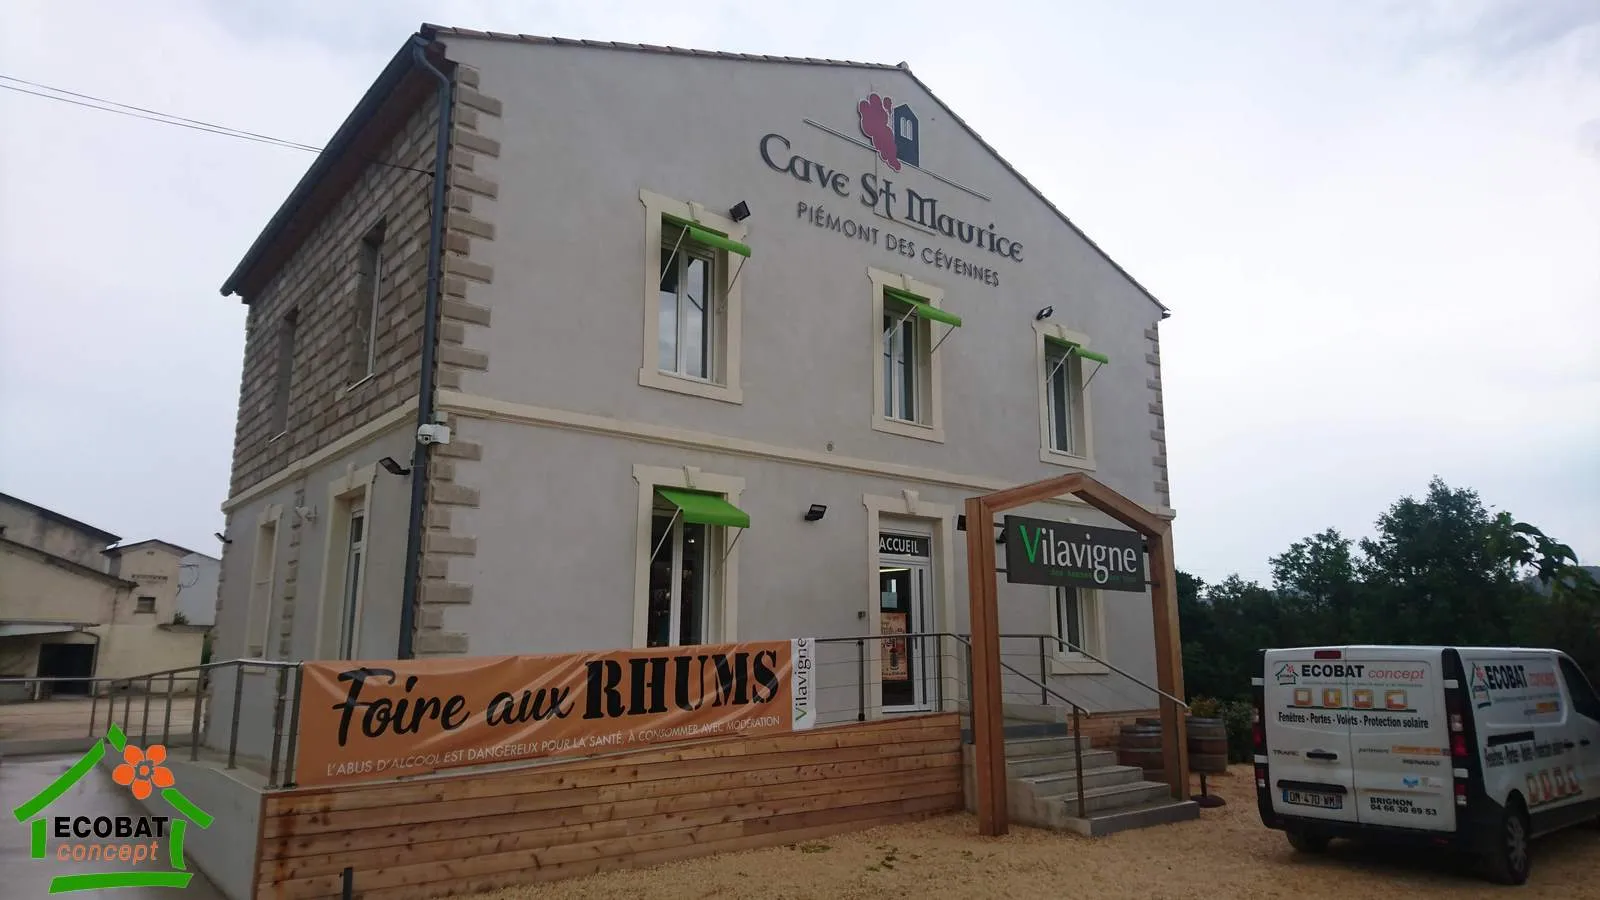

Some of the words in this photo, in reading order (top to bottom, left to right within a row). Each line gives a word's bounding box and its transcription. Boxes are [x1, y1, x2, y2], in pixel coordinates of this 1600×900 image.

[760, 133, 850, 197] Cave
[860, 173, 896, 220] St
[905, 188, 1024, 263] Maurice
[797, 201, 879, 246] PIÉMONT
[886, 233, 915, 258] DES
[921, 248, 1000, 287] CÉVENNES
[879, 537, 919, 554] ACCUEIL
[1019, 525, 1138, 584] Vilavigne
[332, 667, 471, 747] Foire
[486, 685, 575, 727] aux
[582, 650, 779, 719] RHUMS
[795, 637, 811, 723] Vilavigne
[1302, 664, 1364, 678] ECOBAT
[1368, 668, 1425, 681] concept
[1484, 665, 1527, 689] ECOBAT
[1278, 711, 1305, 724] Fenêtres
[1310, 712, 1331, 725] Portes
[1336, 713, 1358, 726] Volets
[1364, 716, 1401, 728] Protection
[1403, 717, 1428, 728] solaire
[327, 761, 373, 776] L'ABUS
[376, 753, 440, 772] D'ALCOOL
[443, 750, 464, 763] EST
[467, 741, 538, 760] DANGEREUX
[541, 739, 571, 752] POUR
[573, 737, 586, 749] LA
[628, 729, 636, 743] À
[638, 724, 699, 742] CONSOMMER
[702, 722, 724, 734] AVEC
[1370, 797, 1413, 807] BRIGNON
